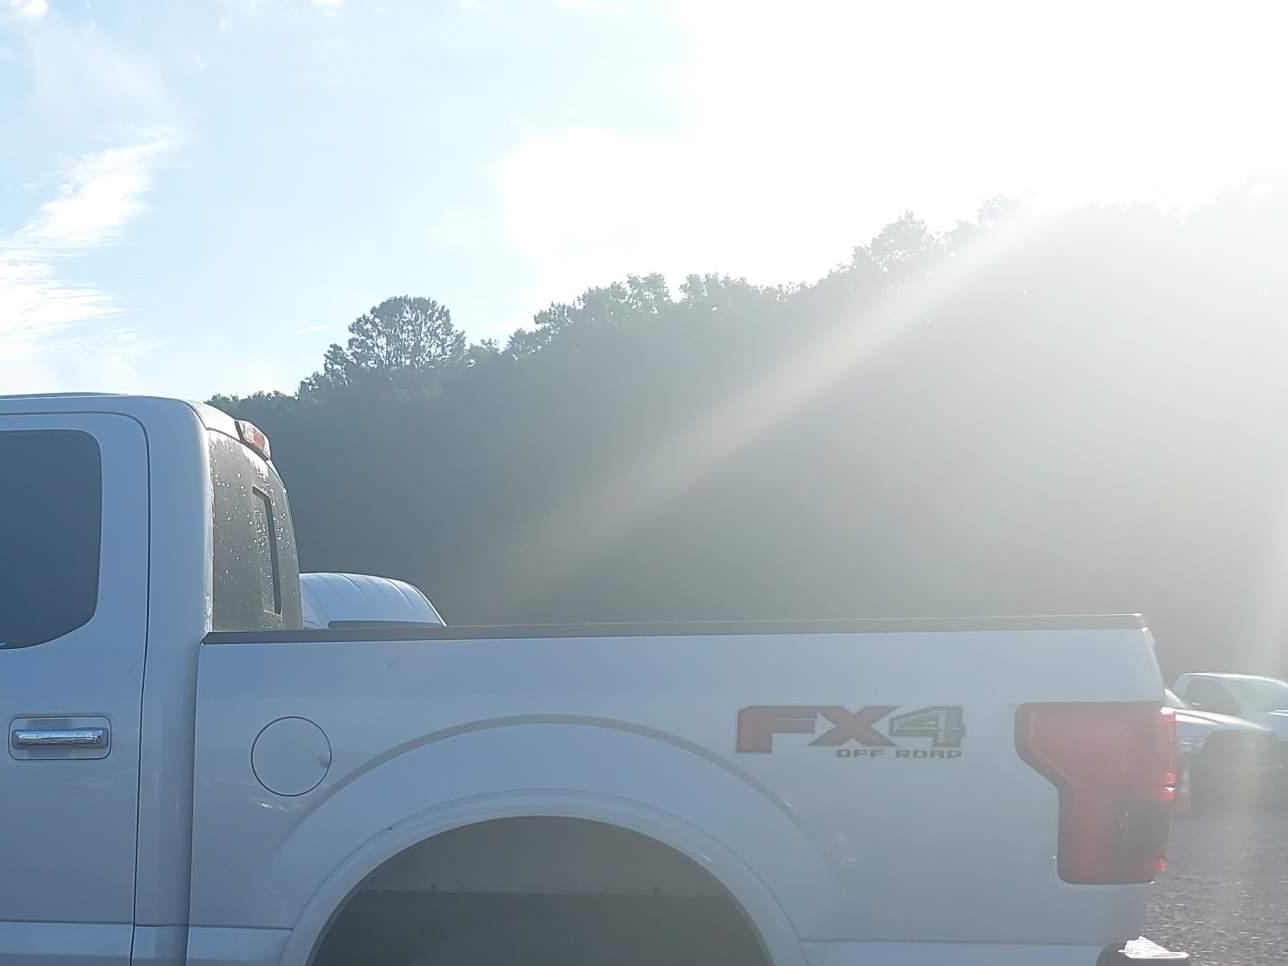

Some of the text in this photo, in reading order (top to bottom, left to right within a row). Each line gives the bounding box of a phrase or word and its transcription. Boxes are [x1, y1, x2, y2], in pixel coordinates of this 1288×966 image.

[736, 705, 966, 753] FX4
[836, 749, 962, 759] OFF ROAD
